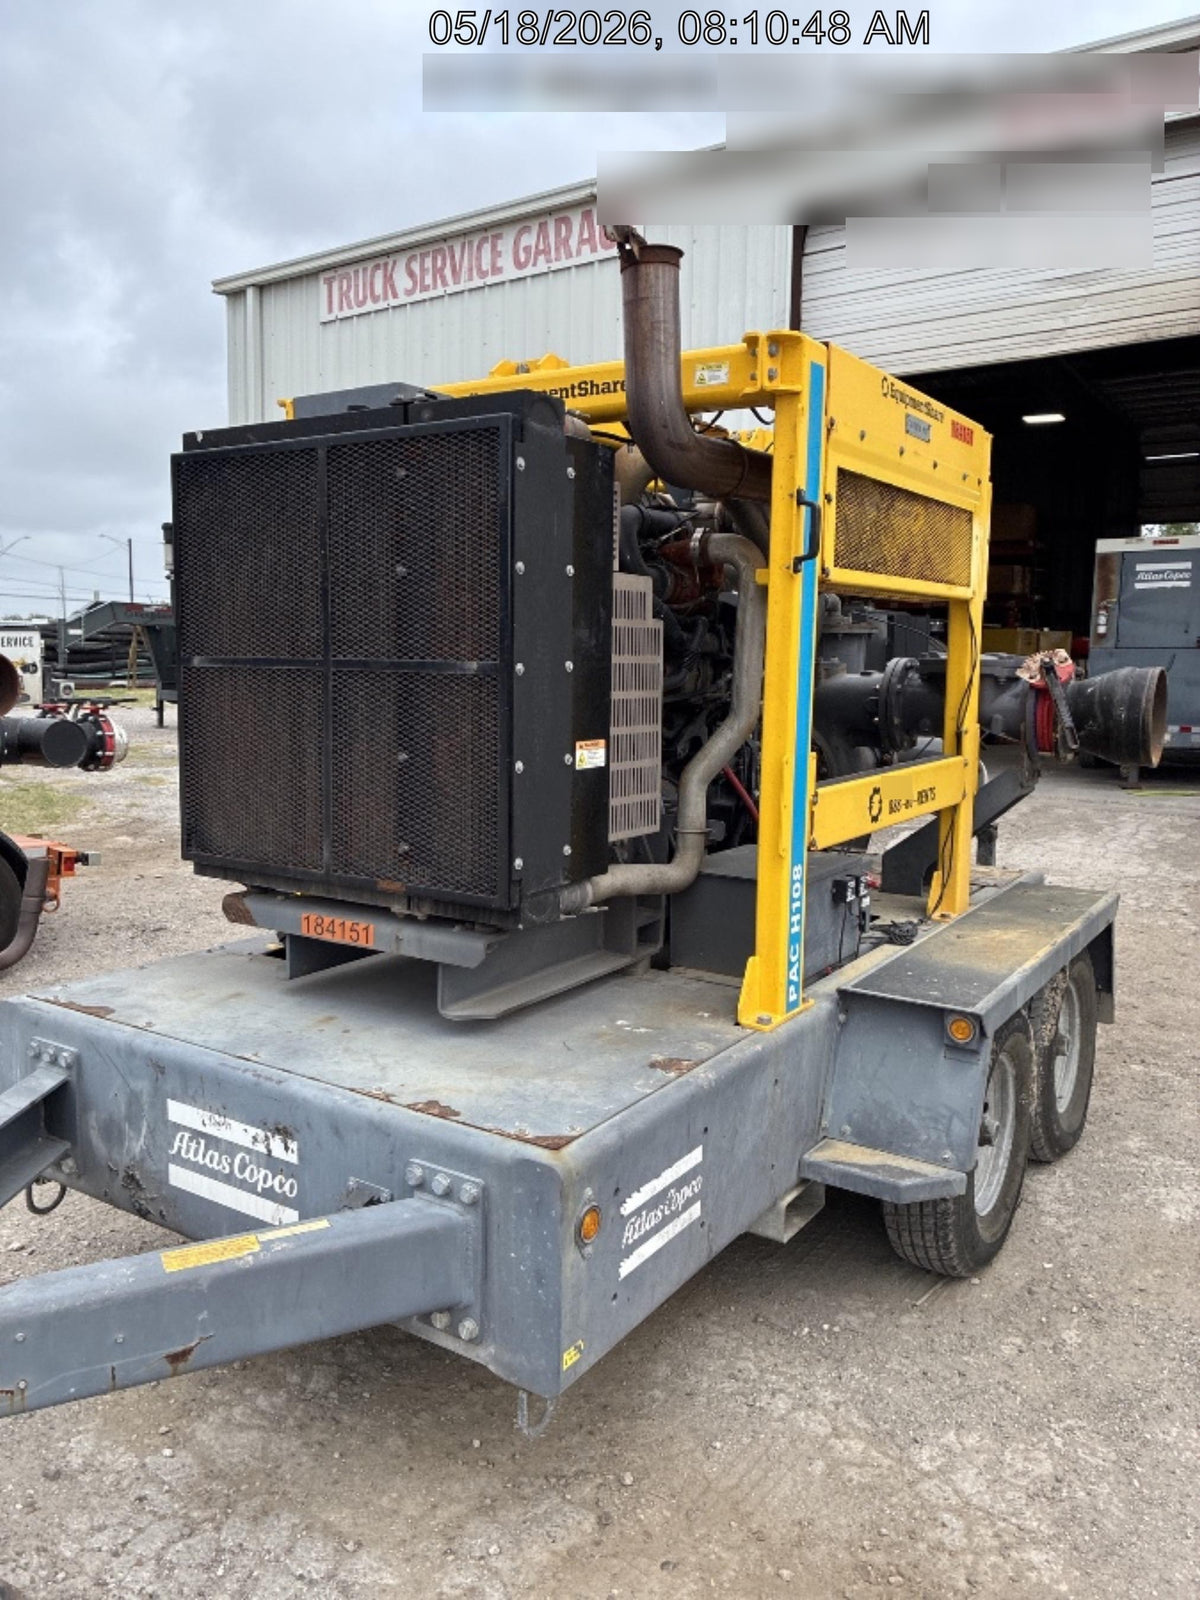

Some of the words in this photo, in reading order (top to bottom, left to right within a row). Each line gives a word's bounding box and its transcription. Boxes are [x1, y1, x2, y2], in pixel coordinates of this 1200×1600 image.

[323, 259, 399, 315] TRUCK
[403, 232, 504, 297] SERVICE
[1, 636, 34, 648] ERVICE
[790, 864, 803, 934] H108
[303, 914, 370, 945] 184151
[788, 943, 801, 1002] PAC
[168, 1131, 231, 1174] Atlas
[234, 1152, 297, 1197] Copco
[621, 1204, 663, 1249] Atlas
